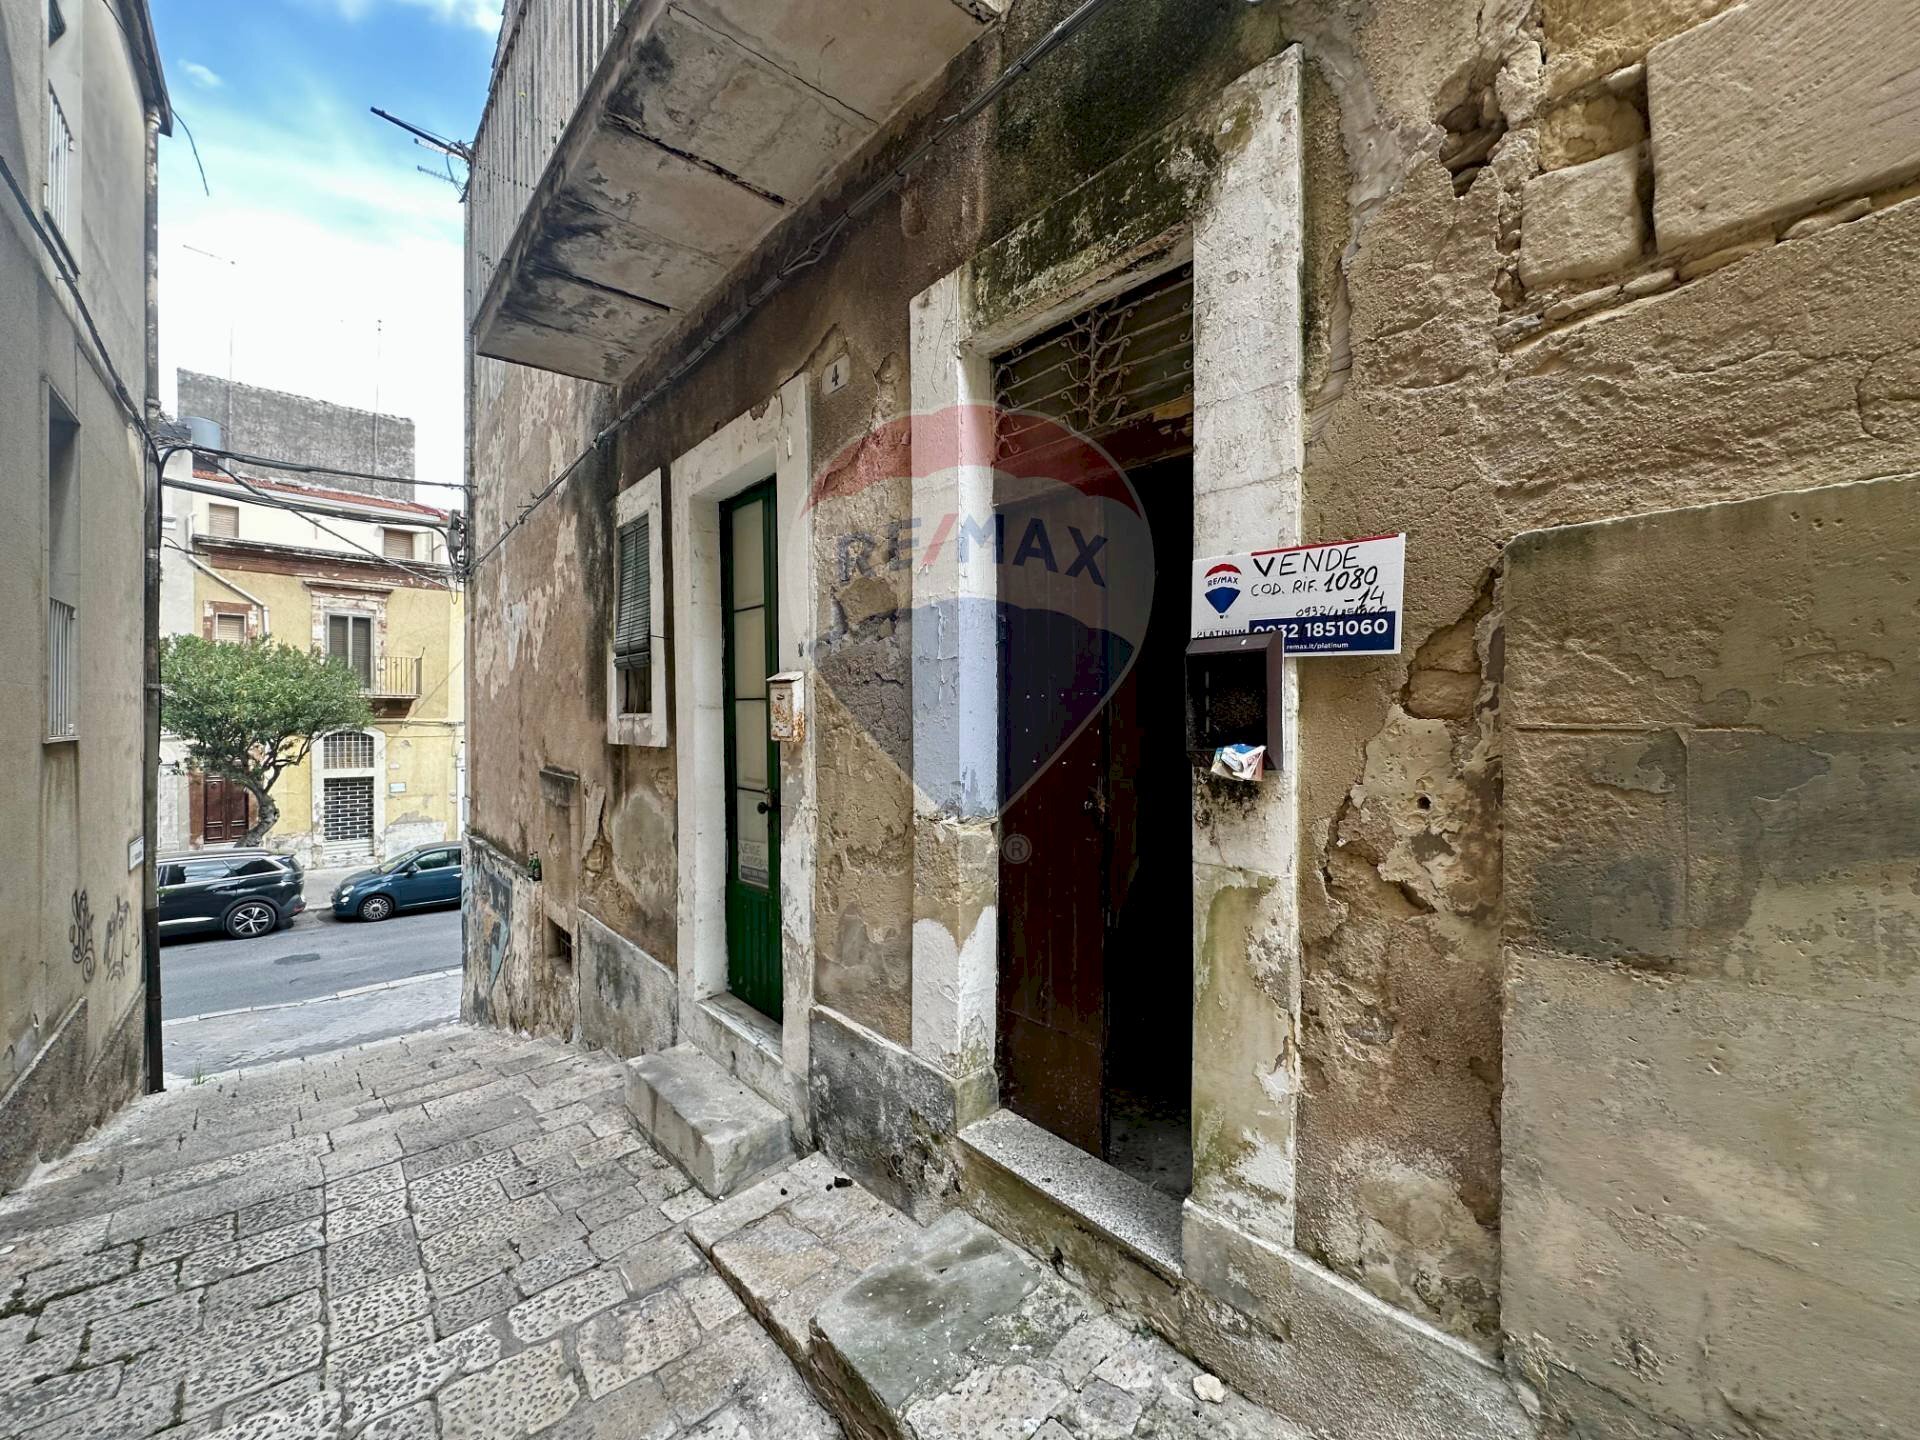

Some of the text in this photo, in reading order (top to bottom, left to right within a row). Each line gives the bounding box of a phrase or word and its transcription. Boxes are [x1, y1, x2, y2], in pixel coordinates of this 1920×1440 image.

[831, 363, 840, 388] 4
[1252, 544, 1360, 577] VENDE
[1207, 576, 1239, 588] RE/MAX
[1250, 565, 1378, 597] COD. RIF. 1080
[1304, 618, 1389, 638] 1851060
